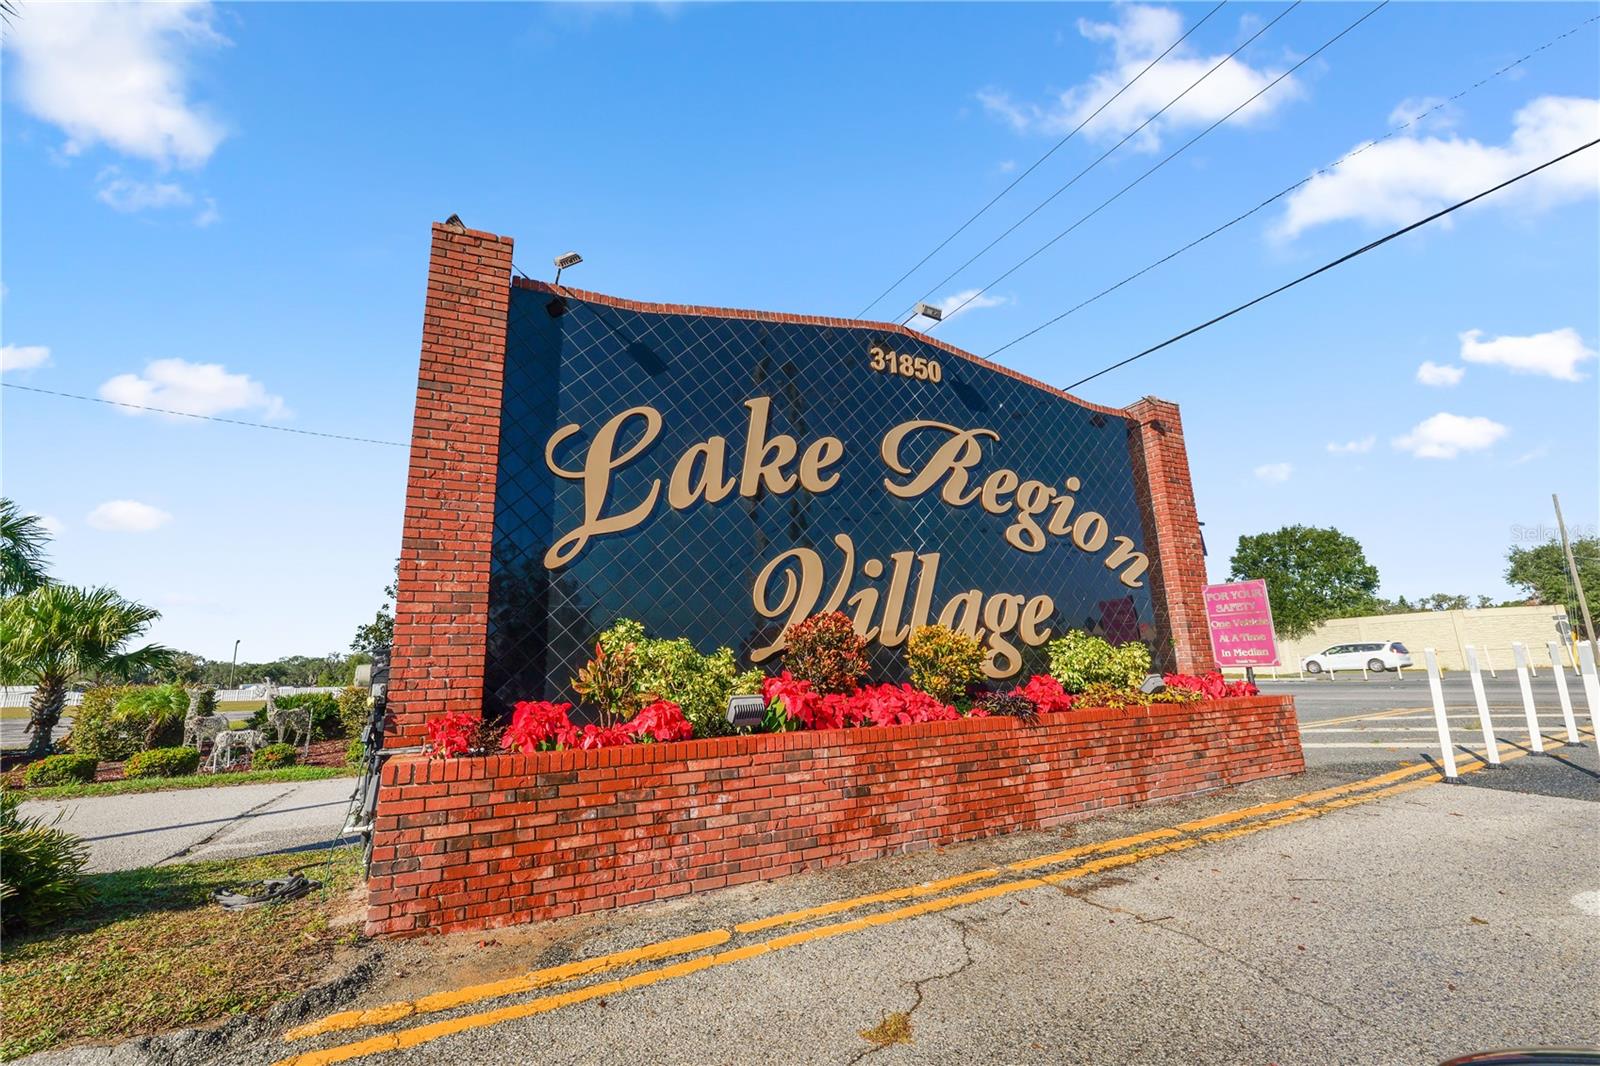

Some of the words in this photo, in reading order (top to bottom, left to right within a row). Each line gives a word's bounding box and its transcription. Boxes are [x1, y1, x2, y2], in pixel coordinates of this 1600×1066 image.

[870, 347, 942, 383] 31850
[543, 396, 844, 569] Lake
[881, 420, 1149, 587] Region
[1206, 591, 1229, 602] FOR
[1231, 588, 1263, 600] YOUR
[750, 533, 1055, 679] Village
[1215, 601, 1256, 613] SAFETY
[1210, 620, 1231, 629] One
[1232, 617, 1269, 627] Vehicle
[1219, 634, 1230, 643] At
[1231, 633, 1239, 642] A
[1240, 632, 1266, 641] Time
[1221, 649, 1231, 657] In
[1233, 647, 1270, 657] Median
